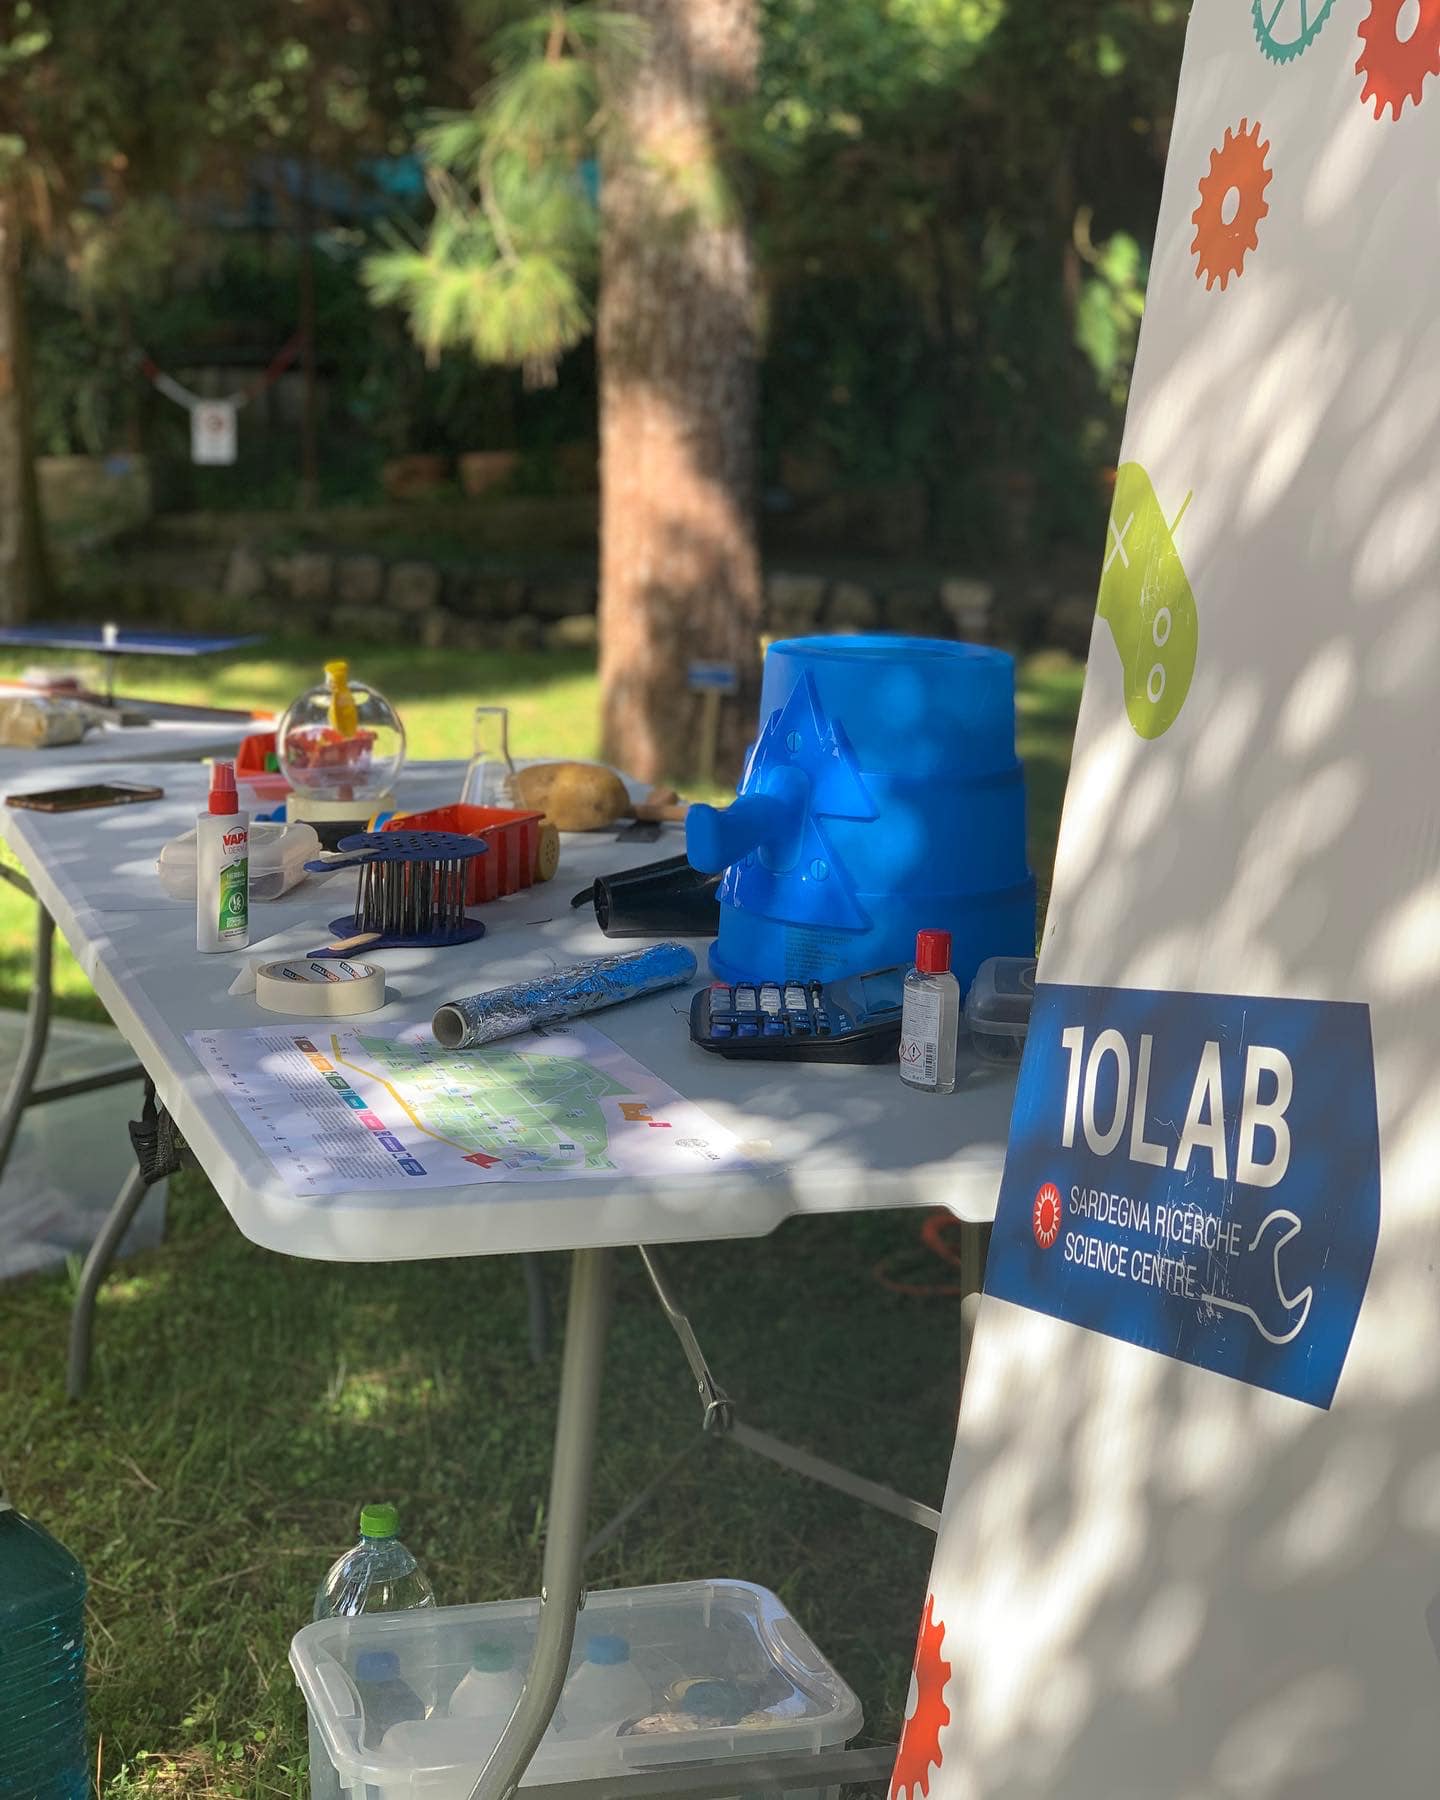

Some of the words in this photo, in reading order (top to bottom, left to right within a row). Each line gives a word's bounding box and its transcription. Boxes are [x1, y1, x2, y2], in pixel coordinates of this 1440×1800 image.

[1061, 1026, 1294, 1189] 10LAB
[1069, 1185, 1151, 1234] SARDEGNA
[1154, 1205, 1242, 1257] RICERCHE
[1064, 1231, 1129, 1277] SCIENCE
[1130, 1250, 1197, 1298] CENTRE
